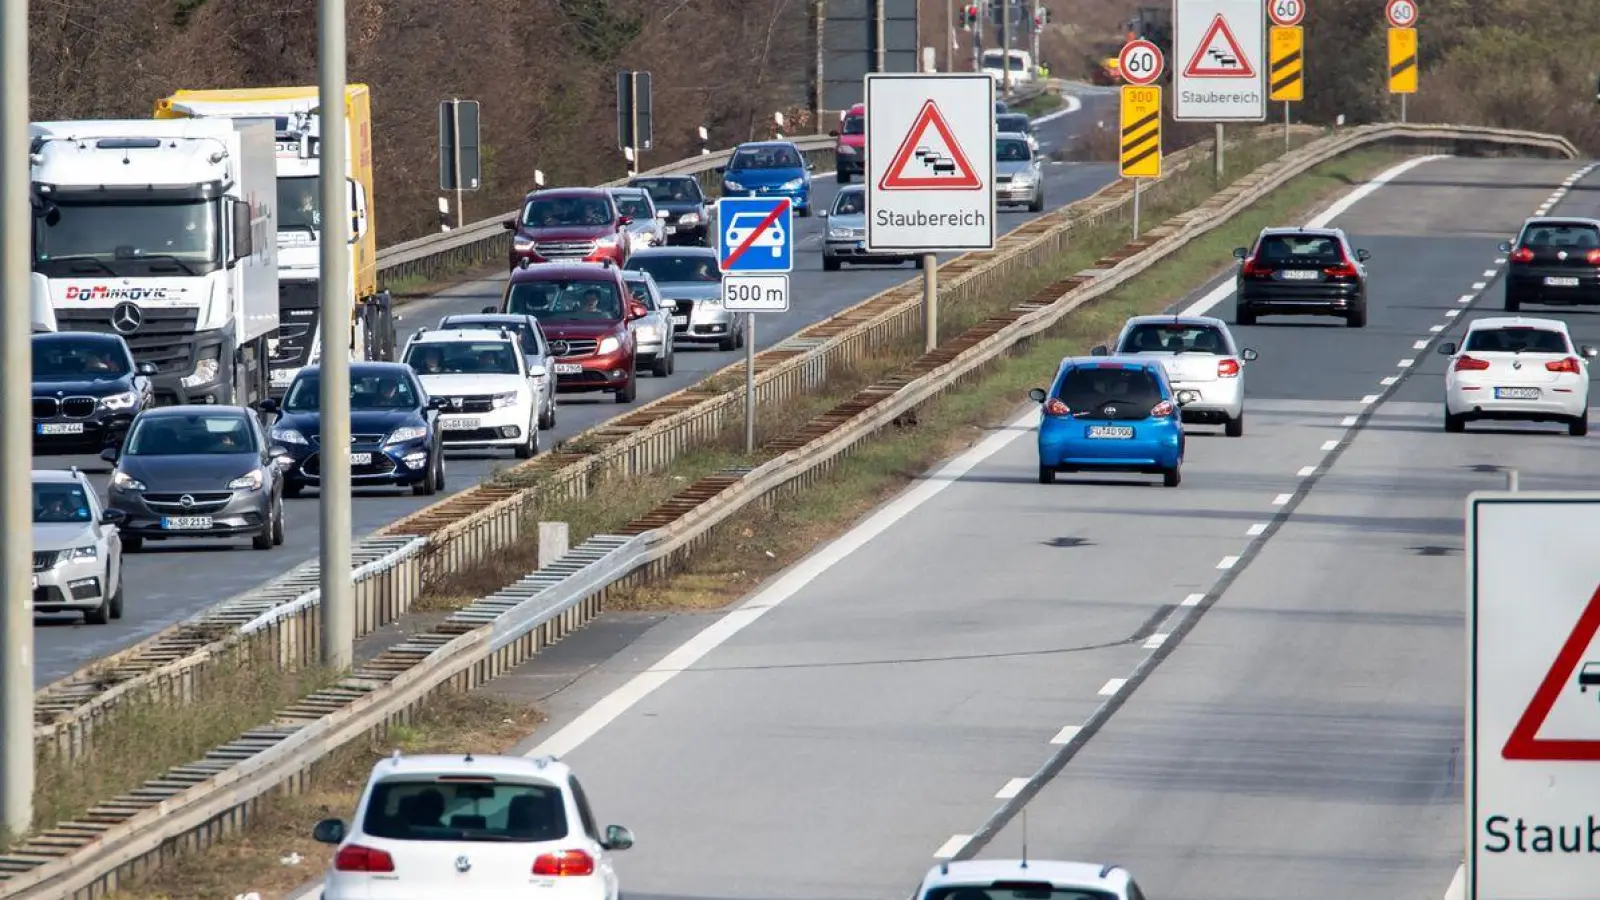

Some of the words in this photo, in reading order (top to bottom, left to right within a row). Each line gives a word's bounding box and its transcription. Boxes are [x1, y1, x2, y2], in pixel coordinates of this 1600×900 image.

[1276, 1, 1297, 16] 60
[1393, 5, 1411, 20] 60
[1128, 52, 1153, 72] 60
[1129, 91, 1153, 103] 300
[1181, 91, 1259, 103] Staubereich
[876, 209, 985, 226] Staubereich
[727, 285, 761, 301] 500
[766, 288, 783, 301] m
